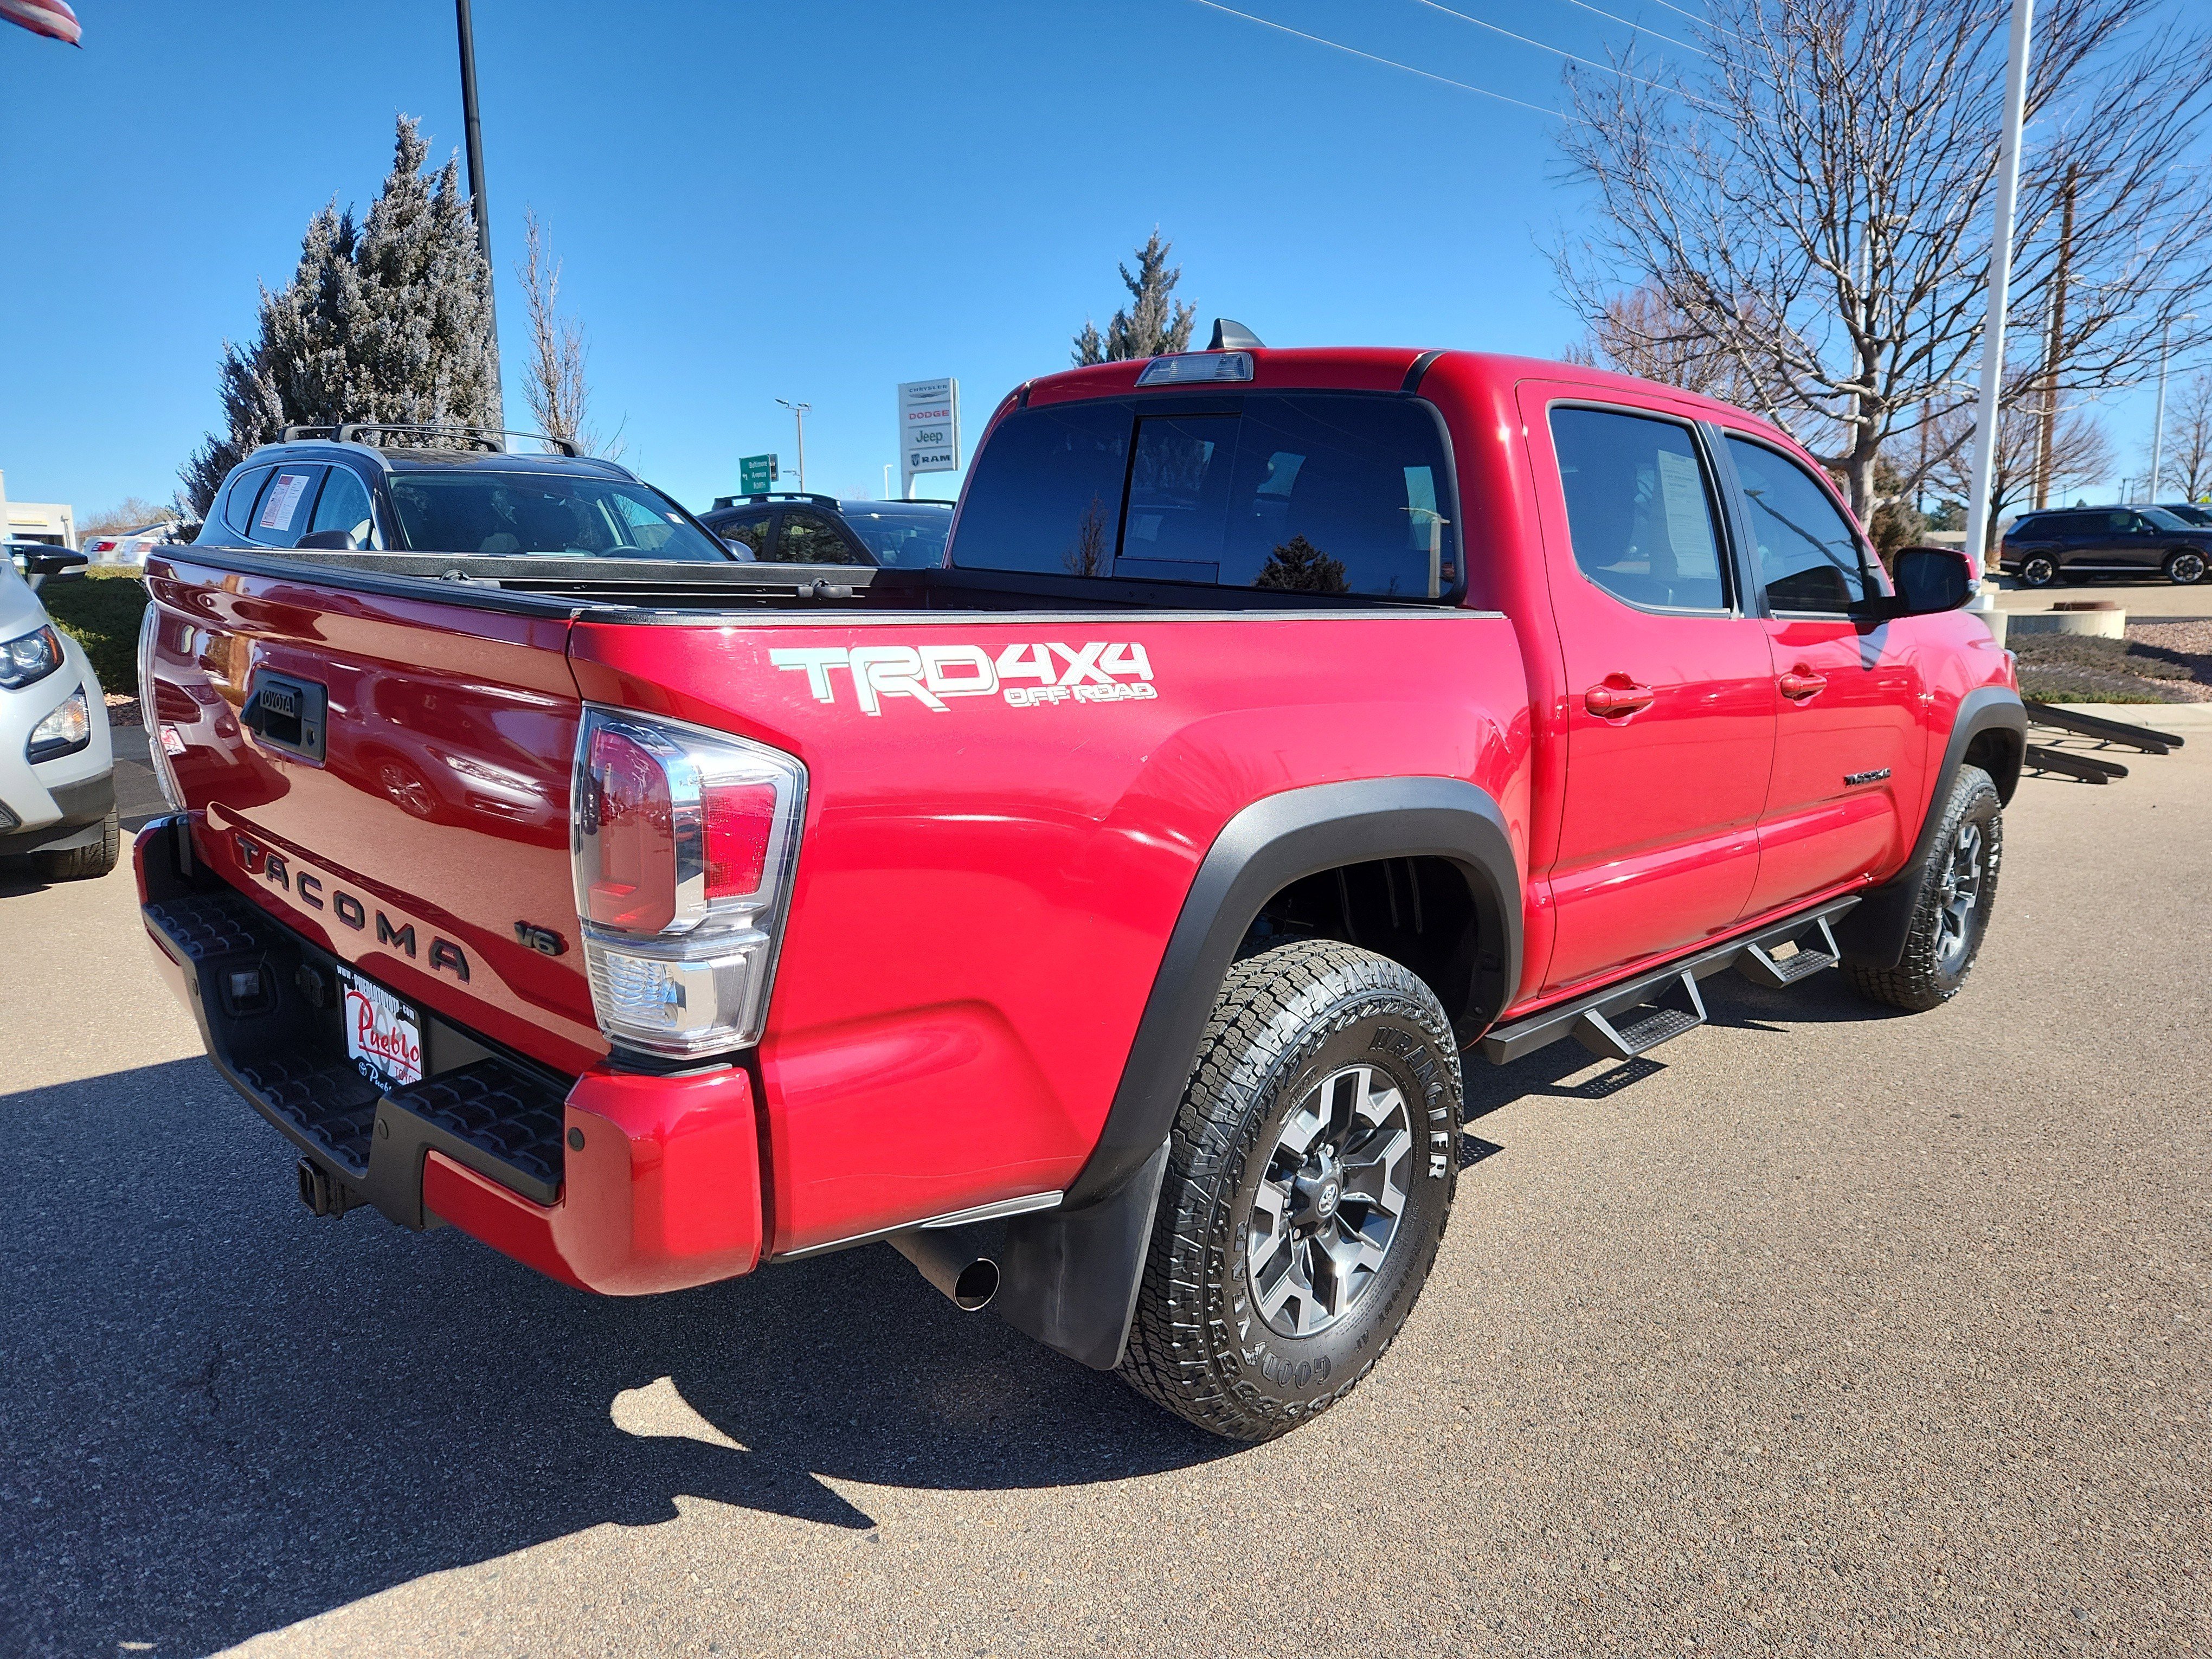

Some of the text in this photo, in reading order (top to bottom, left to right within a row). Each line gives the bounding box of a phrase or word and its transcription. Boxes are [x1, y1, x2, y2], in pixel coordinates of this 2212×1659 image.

[909, 384, 948, 393] CHRYSLER
[909, 410, 949, 420] DODGE
[916, 430, 943, 444] Jeep
[922, 454, 951, 464] RAM
[768, 641, 1155, 717] TRD 4X4
[260, 689, 294, 714] TOYOTA
[1002, 681, 1159, 708] OFF ROAD
[235, 833, 471, 985] TACOMA
[513, 921, 562, 956] V6
[346, 991, 420, 1062] Pueblo
[1368, 1026, 1449, 1179] WRANGLER
